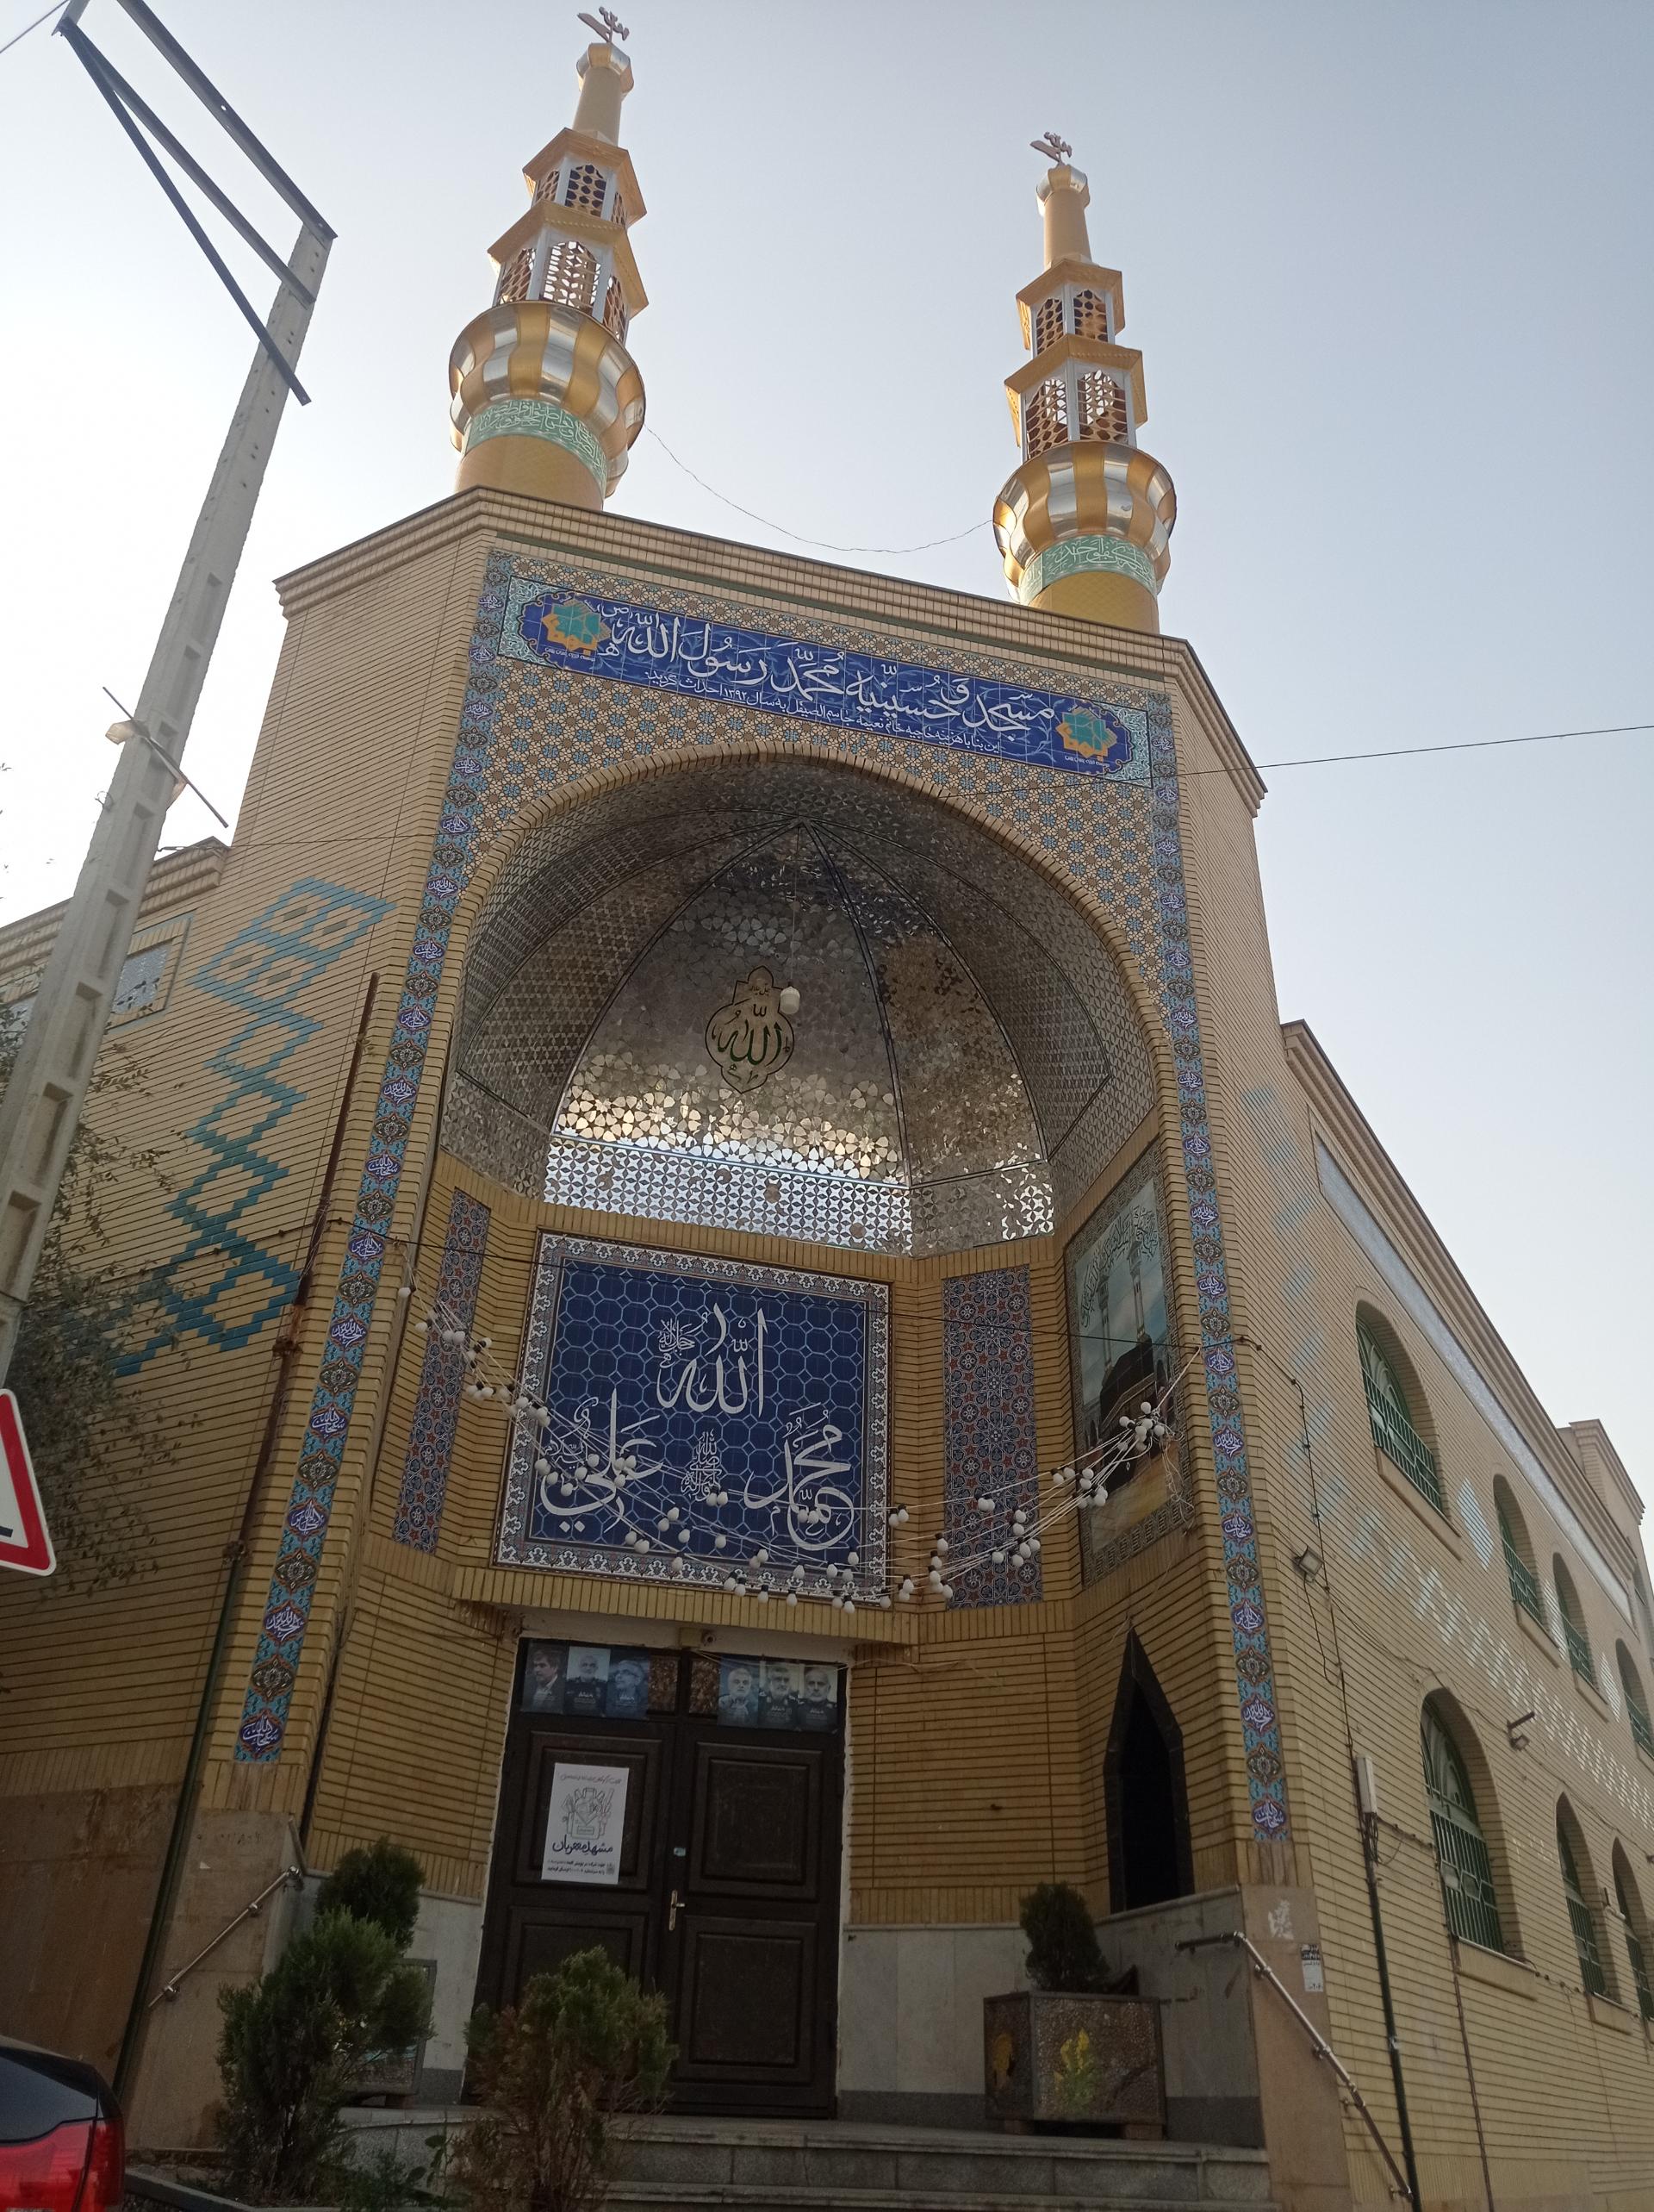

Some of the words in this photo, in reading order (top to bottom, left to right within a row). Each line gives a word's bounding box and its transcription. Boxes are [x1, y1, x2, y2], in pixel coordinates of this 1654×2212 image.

[612, 614, 681, 663] الله
[678, 623, 768, 686] رسول
[644, 670, 677, 688] گردید
[771, 650, 847, 701] محمد
[679, 677, 723, 697] احداث
[724, 688, 748, 701] ۱۳۹۲
[846, 668, 961, 720] حسینیه
[747, 692, 775, 705] سال
[826, 707, 855, 725] جاسم
[856, 714, 884, 731] نعیمه
[886, 718, 905, 733] خانم
[962, 692, 1055, 741] مسجد
[906, 726, 936, 738] حاجیه
[936, 729, 963, 745] هزینه
[971, 735, 984, 748] بنا
[985, 732, 1000, 753] این
[718, 1019, 782, 1067] الله
[656, 1303, 768, 1418] الله
[743, 1425, 852, 1551] محمد
[551, 1834, 588, 1855] مهربان
[586, 1841, 614, 1856] مشهد
